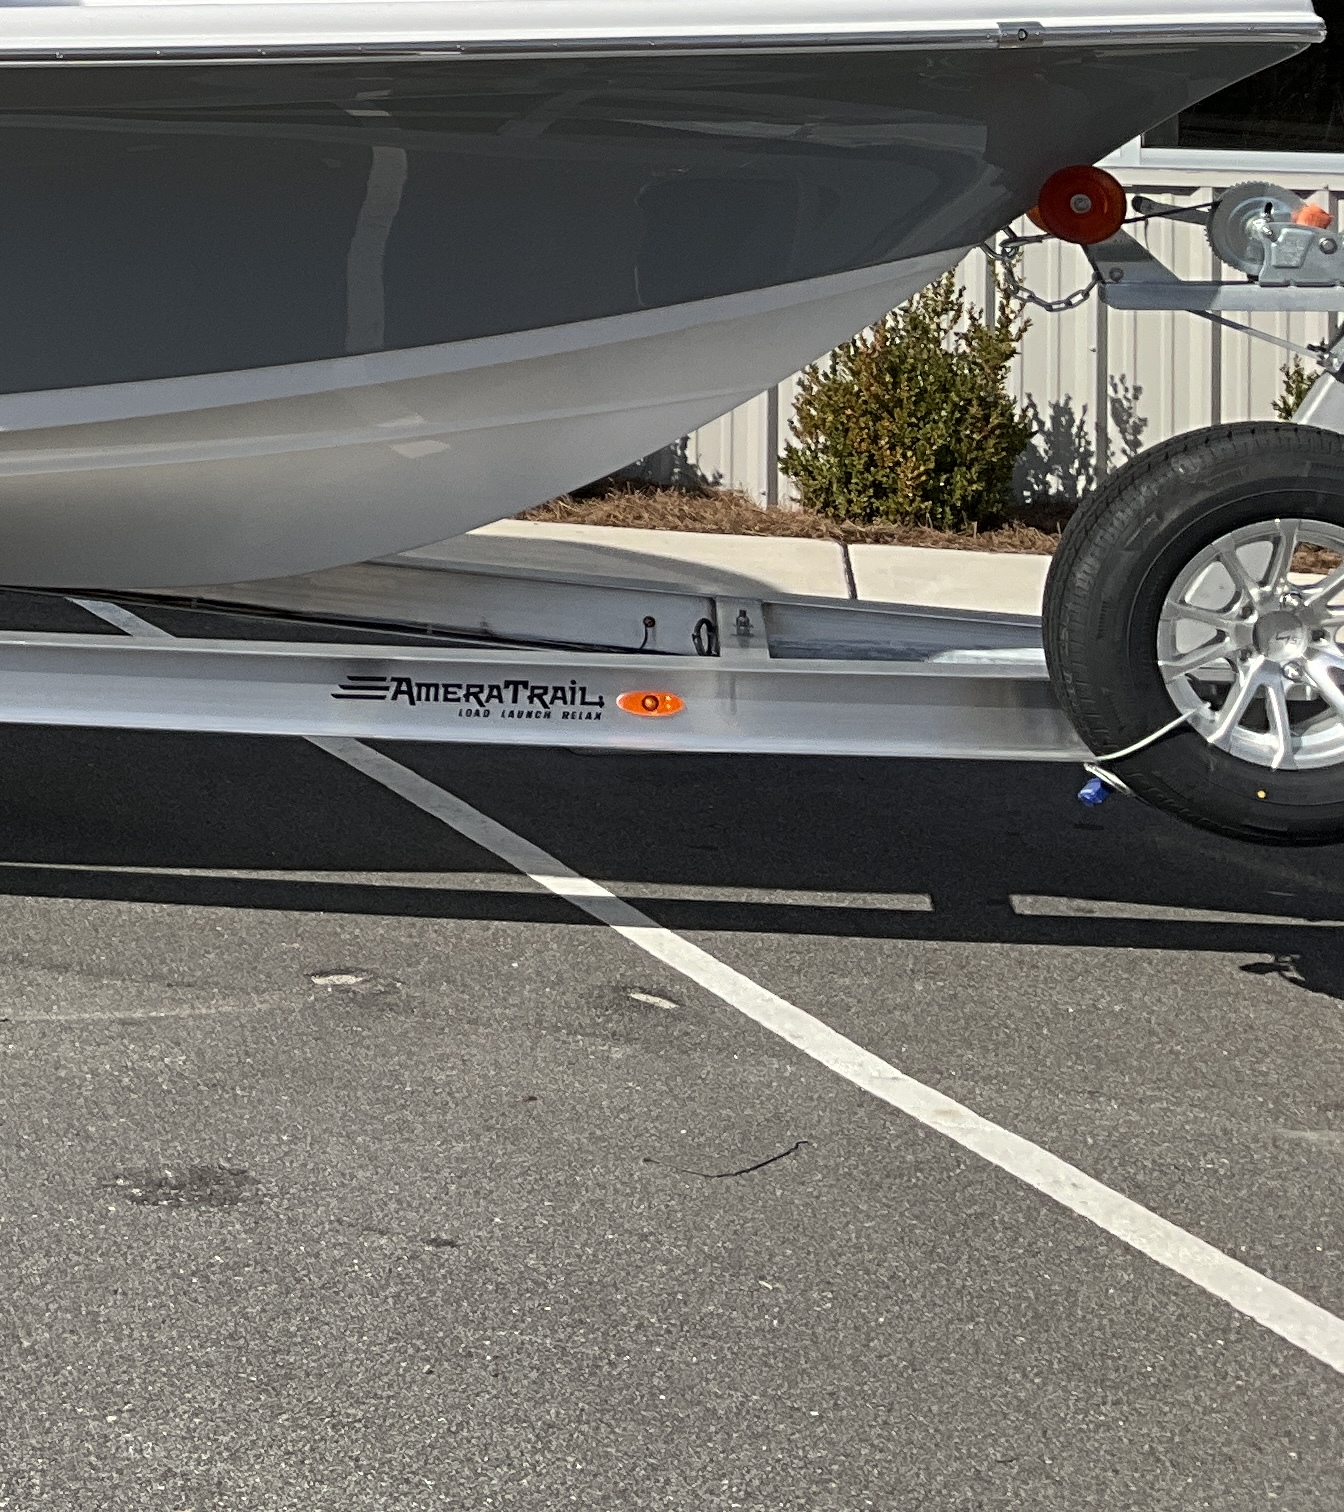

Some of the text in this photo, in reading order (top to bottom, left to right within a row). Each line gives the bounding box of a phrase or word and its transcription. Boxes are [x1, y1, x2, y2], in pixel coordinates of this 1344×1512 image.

[457, 708, 603, 721] LOAD LAUNCH RELAX
